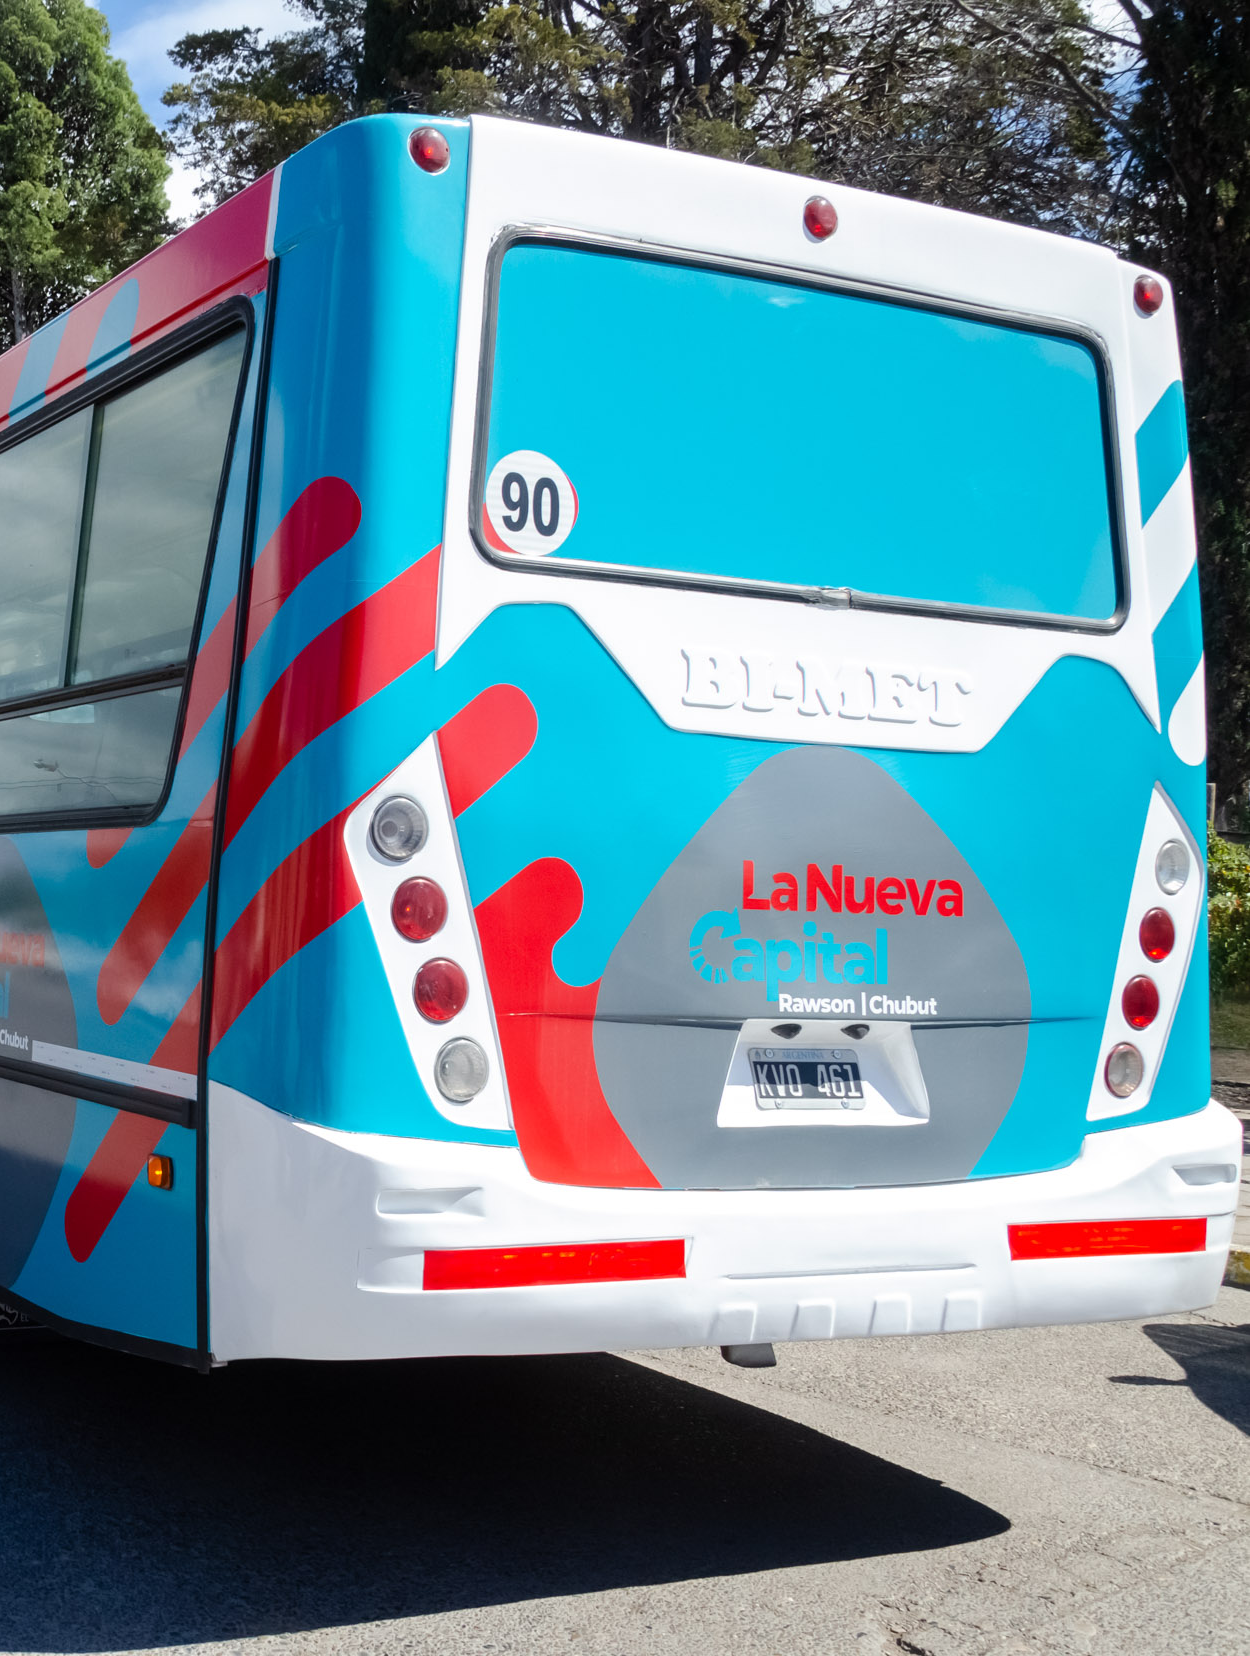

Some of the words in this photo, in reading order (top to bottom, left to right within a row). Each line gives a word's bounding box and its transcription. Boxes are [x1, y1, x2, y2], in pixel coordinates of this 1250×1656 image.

[501, 471, 560, 537] 90
[689, 905, 889, 1002] Capital
[778, 993, 856, 1014] Rawson
[869, 995, 938, 1016] Chubut
[0, 1029, 30, 1051] Chubut
[781, 1050, 825, 1060] ARGENTINA
[756, 1063, 803, 1097] KVO
[816, 1064, 862, 1097] 461
